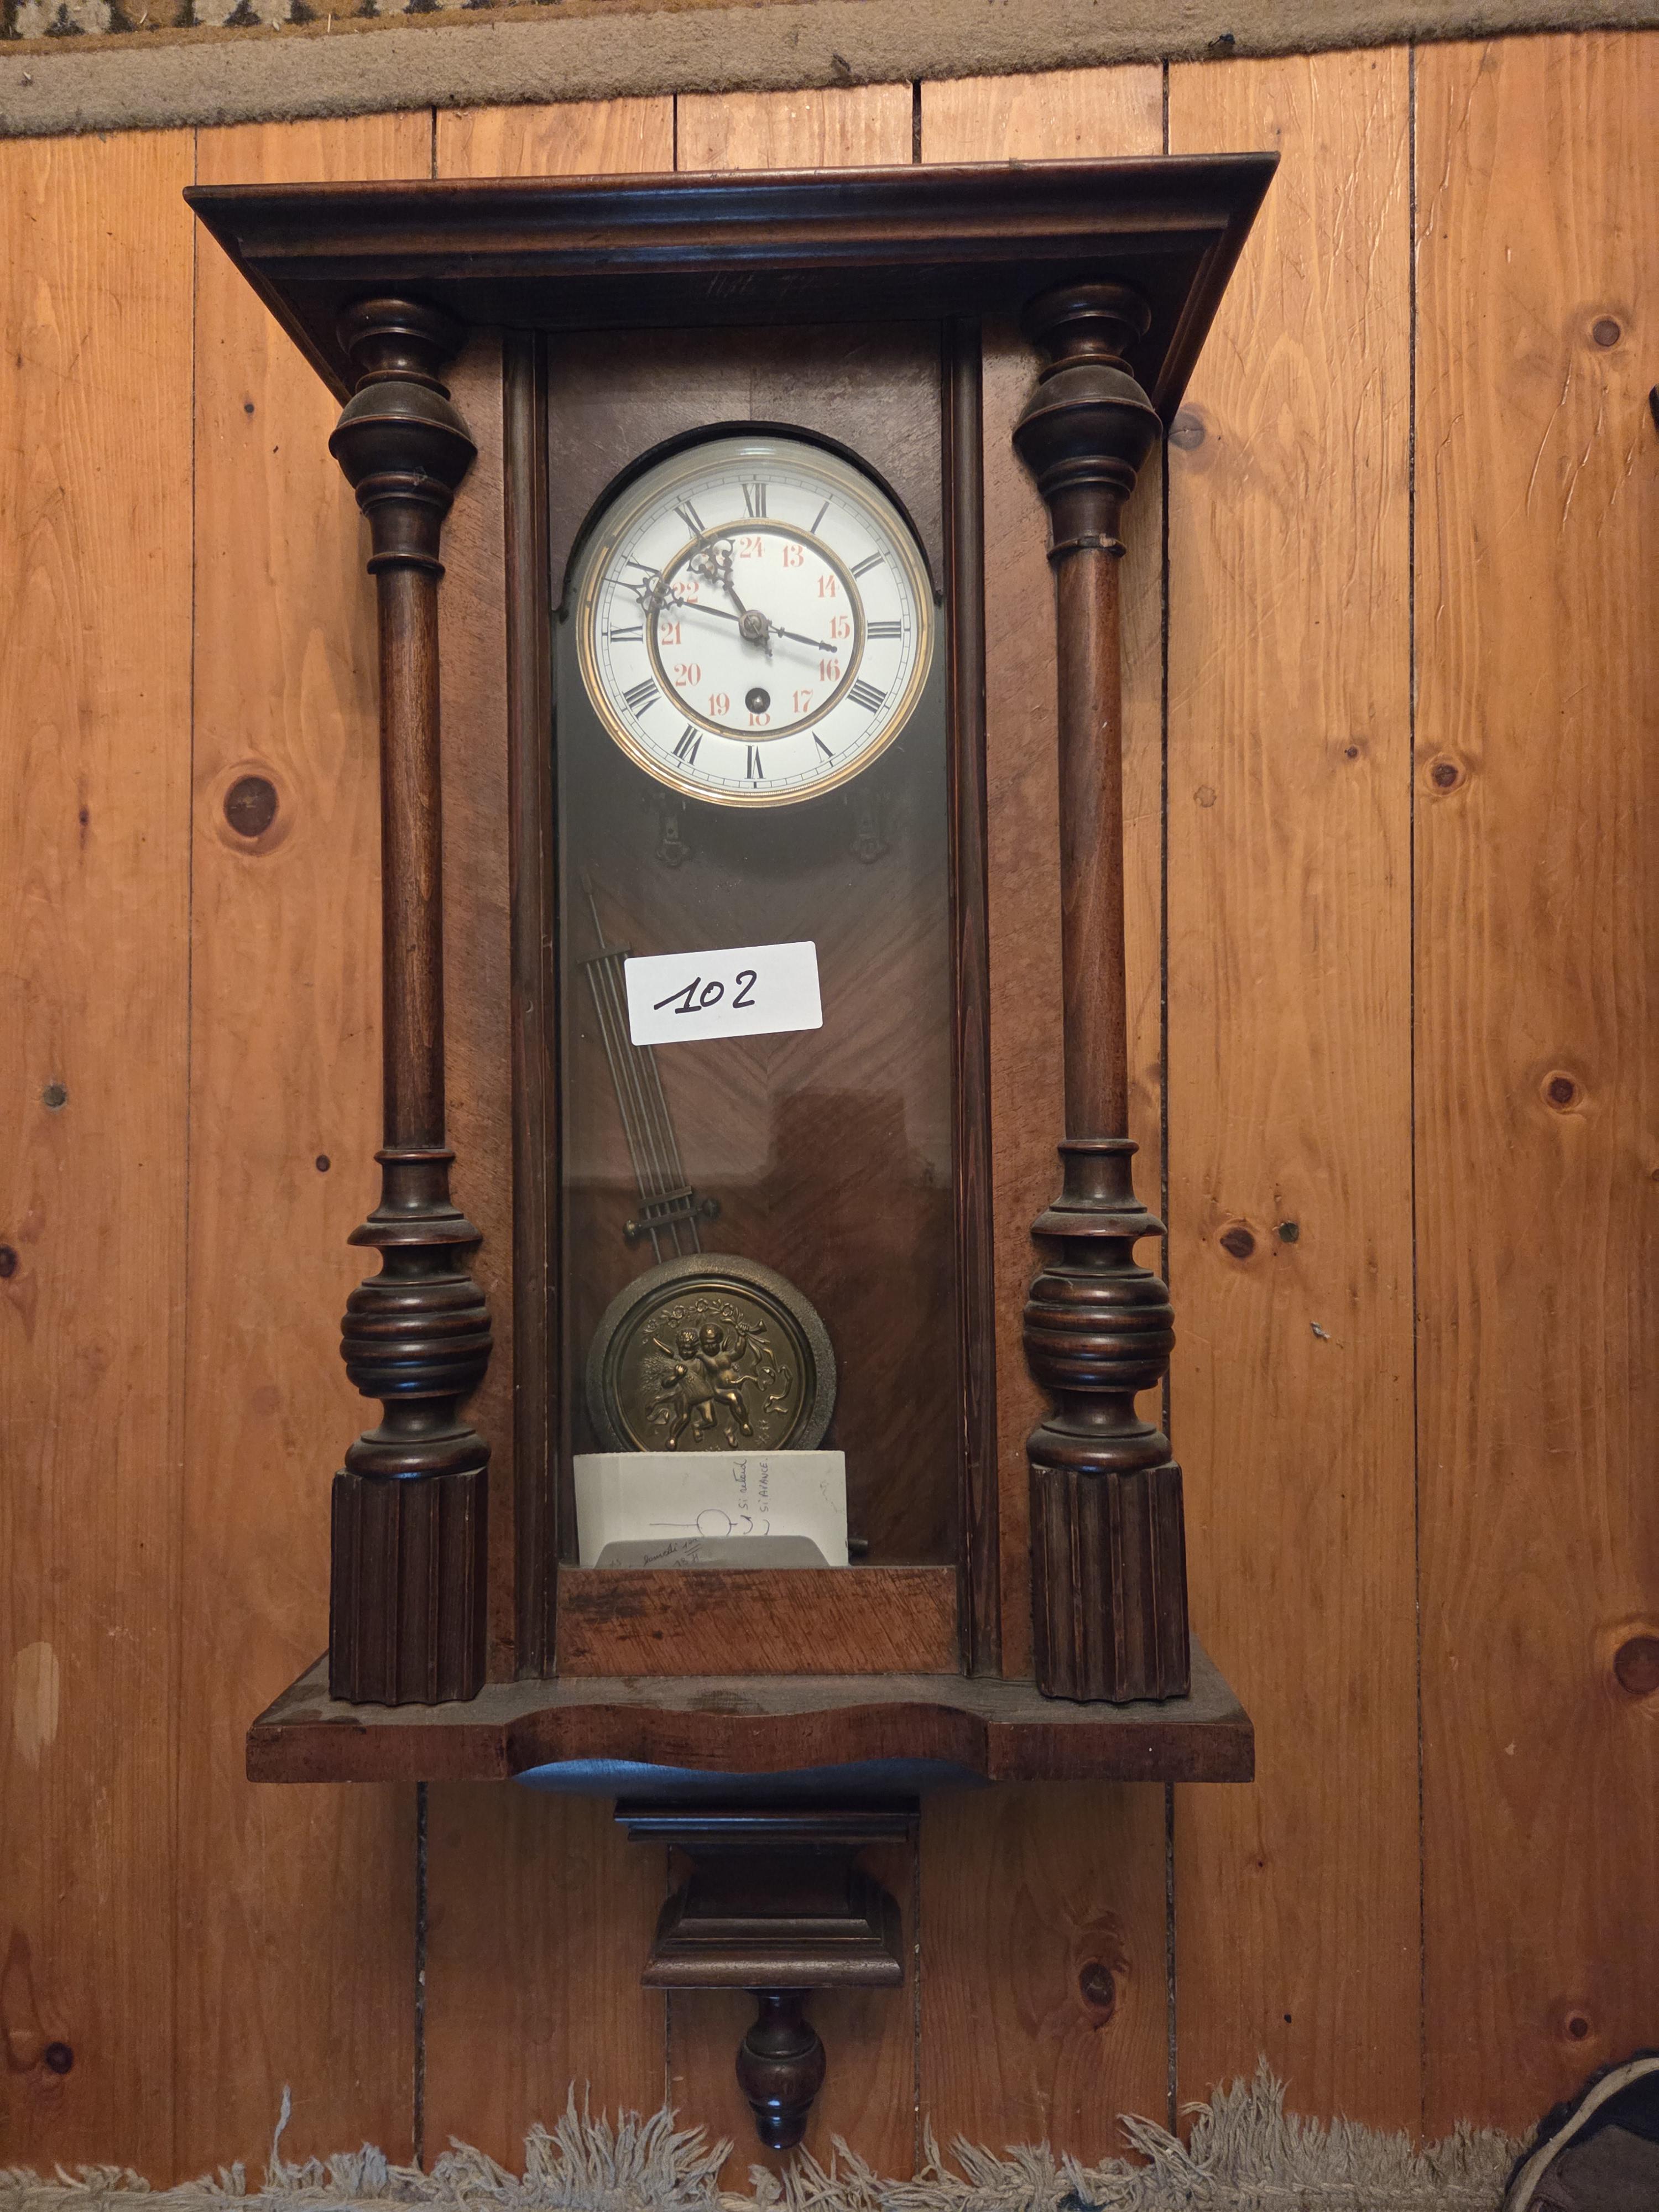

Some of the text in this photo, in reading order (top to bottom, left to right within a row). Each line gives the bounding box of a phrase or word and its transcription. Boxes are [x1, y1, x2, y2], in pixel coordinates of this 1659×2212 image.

[739, 483, 770, 519] XII
[739, 536, 766, 559] 24
[782, 545, 805, 568] 13
[848, 548, 886, 581] II
[817, 575, 839, 598] 14
[661, 620, 682, 646] 21
[829, 615, 851, 640] 15
[867, 618, 902, 642] III
[673, 662, 702, 687] 20
[818, 657, 841, 682] 16
[708, 692, 731, 717] 19
[792, 688, 815, 714] 17
[653, 969, 758, 1014] 102
